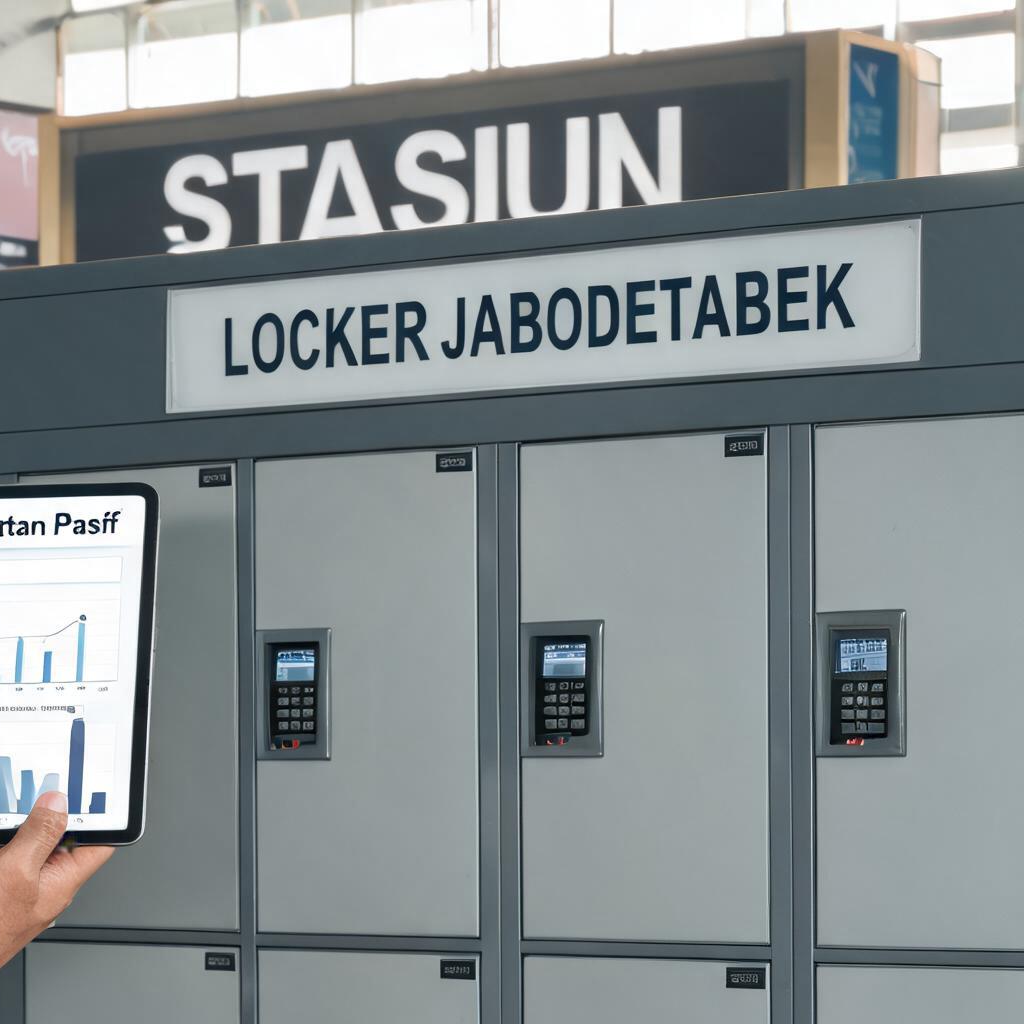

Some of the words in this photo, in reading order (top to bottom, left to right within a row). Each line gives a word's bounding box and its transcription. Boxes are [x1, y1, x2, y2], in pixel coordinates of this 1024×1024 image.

[163, 106, 683, 254] STASIUN
[223, 300, 429, 377] LOCKER
[440, 262, 856, 360] JABODETABEK
